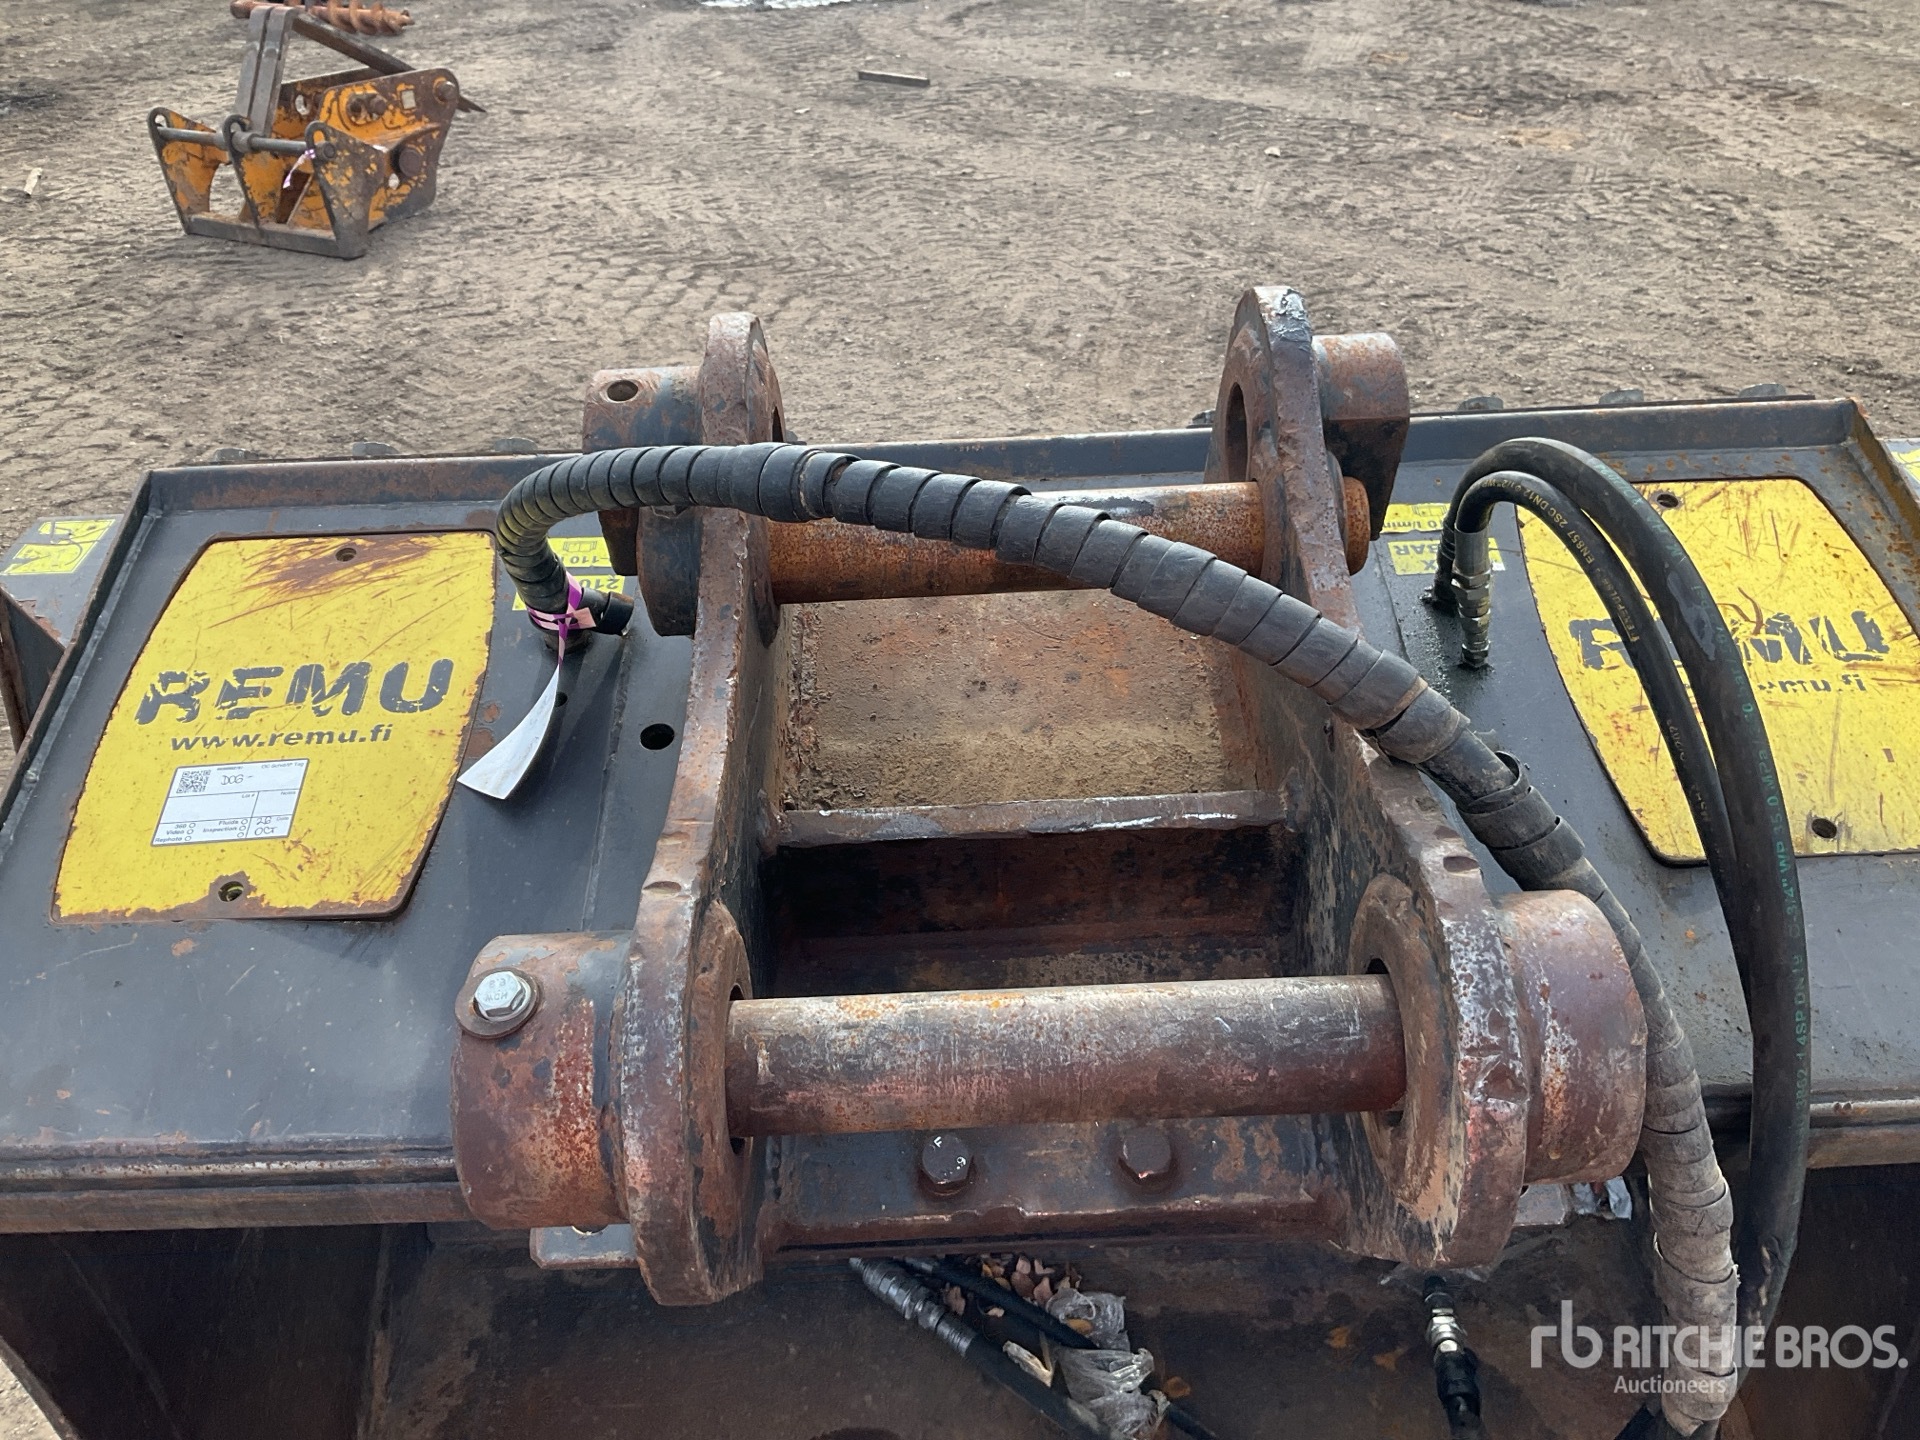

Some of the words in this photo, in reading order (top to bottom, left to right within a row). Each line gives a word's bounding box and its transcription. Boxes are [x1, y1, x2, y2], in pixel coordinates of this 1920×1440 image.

[1523, 488, 1549, 510] DN12
[1548, 506, 1568, 529] 2SC
[1567, 530, 1595, 565] EN857
[134, 658, 455, 725] REMU
[170, 723, 393, 751] www.remu.fi
[202, 825, 238, 833] Inspection
[254, 827, 277, 836] OCT
[1776, 841, 1792, 874] WP
